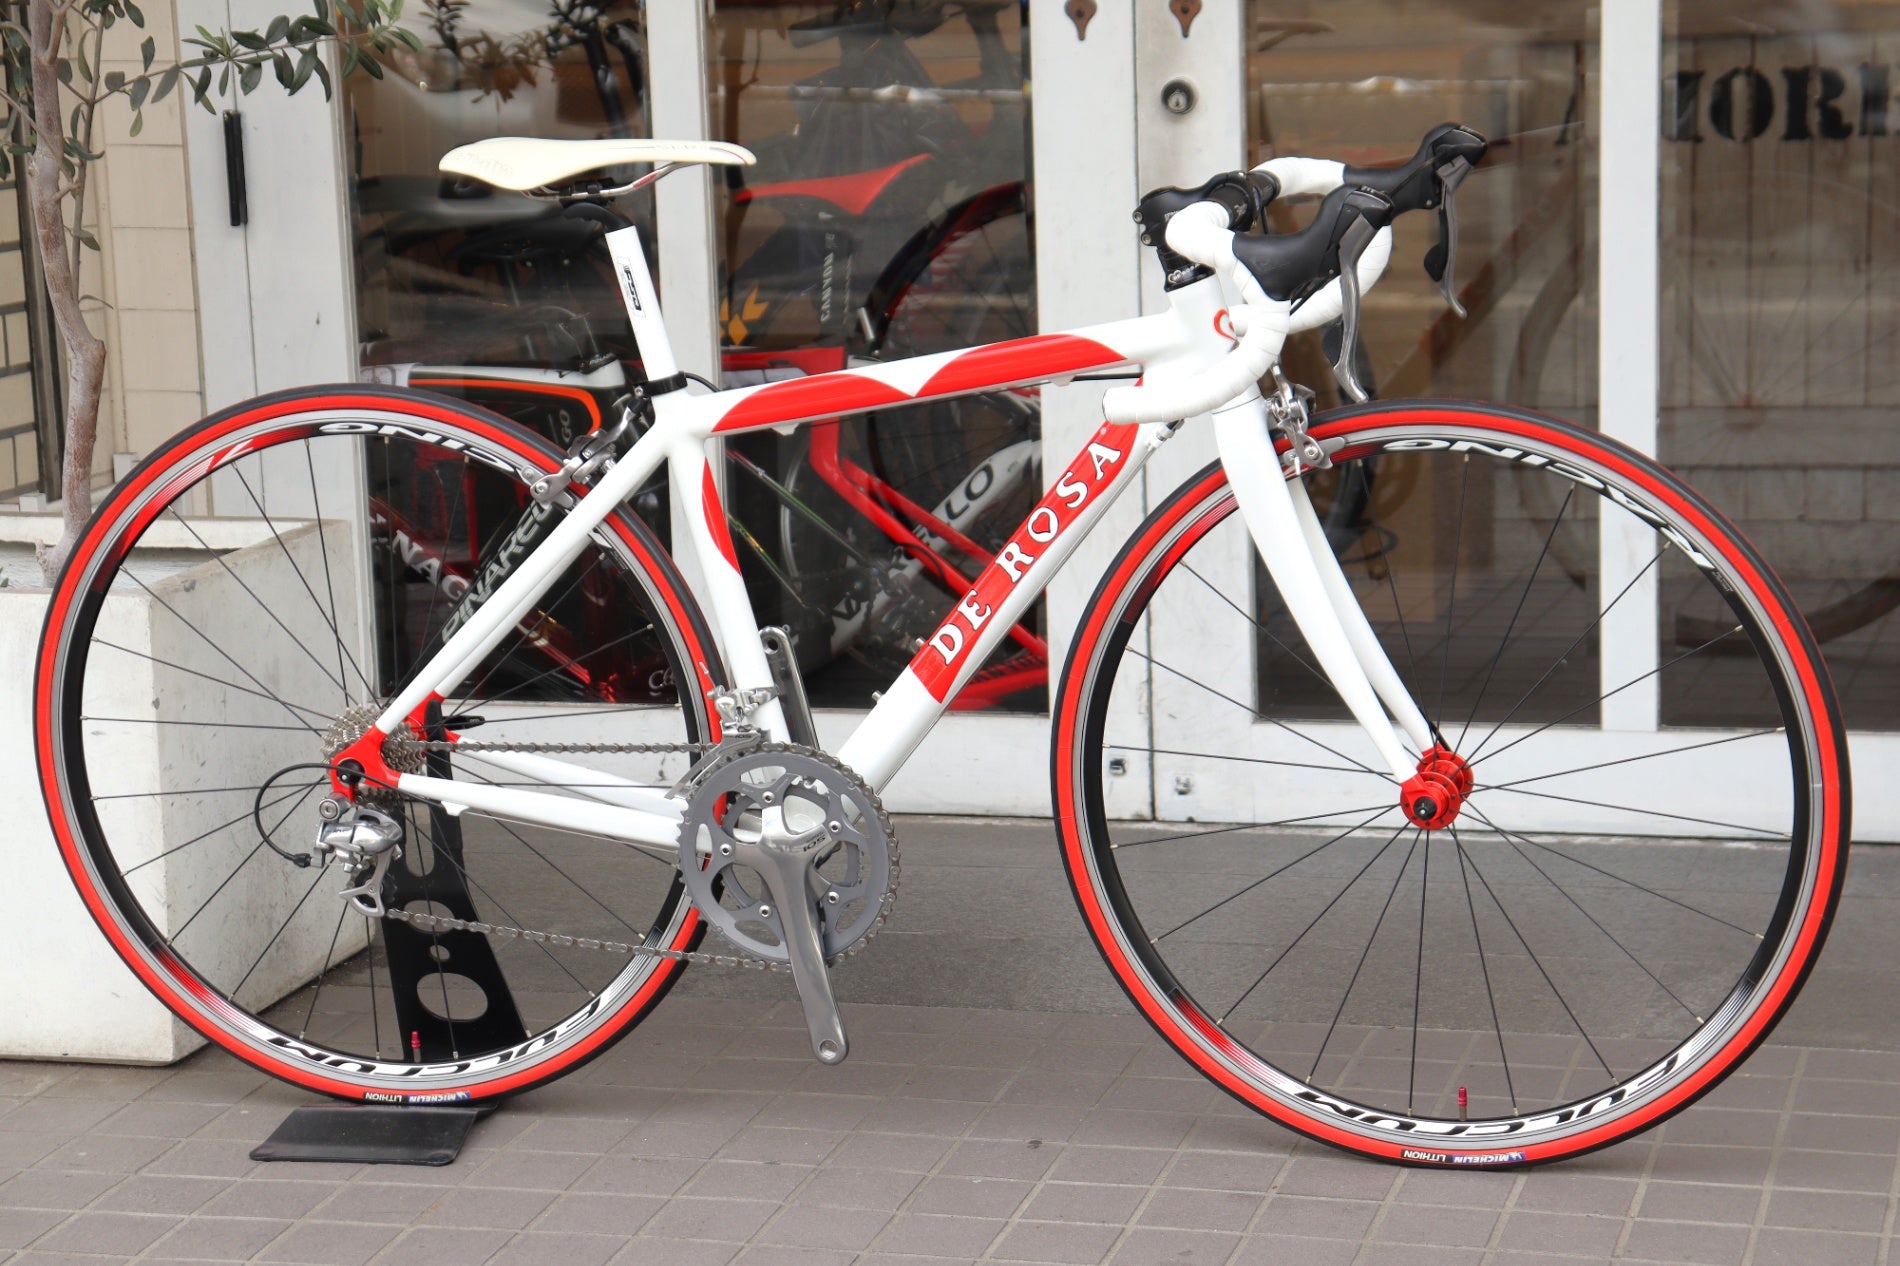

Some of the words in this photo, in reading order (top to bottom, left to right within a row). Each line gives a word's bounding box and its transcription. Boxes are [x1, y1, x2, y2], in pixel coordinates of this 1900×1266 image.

[1383, 438, 1716, 570] RACING
[929, 589, 992, 666] DE
[995, 442, 1122, 583] ROSA
[803, 836, 826, 852] 105
[266, 996, 601, 1077] FULCRUM
[365, 1092, 402, 1102] LITHION
[408, 1093, 457, 1102] MICHELIN
[1294, 1052, 1680, 1136] FULCRUM
[1403, 1150, 1446, 1162] LITHION
[1453, 1153, 1510, 1163] MICHELIN
